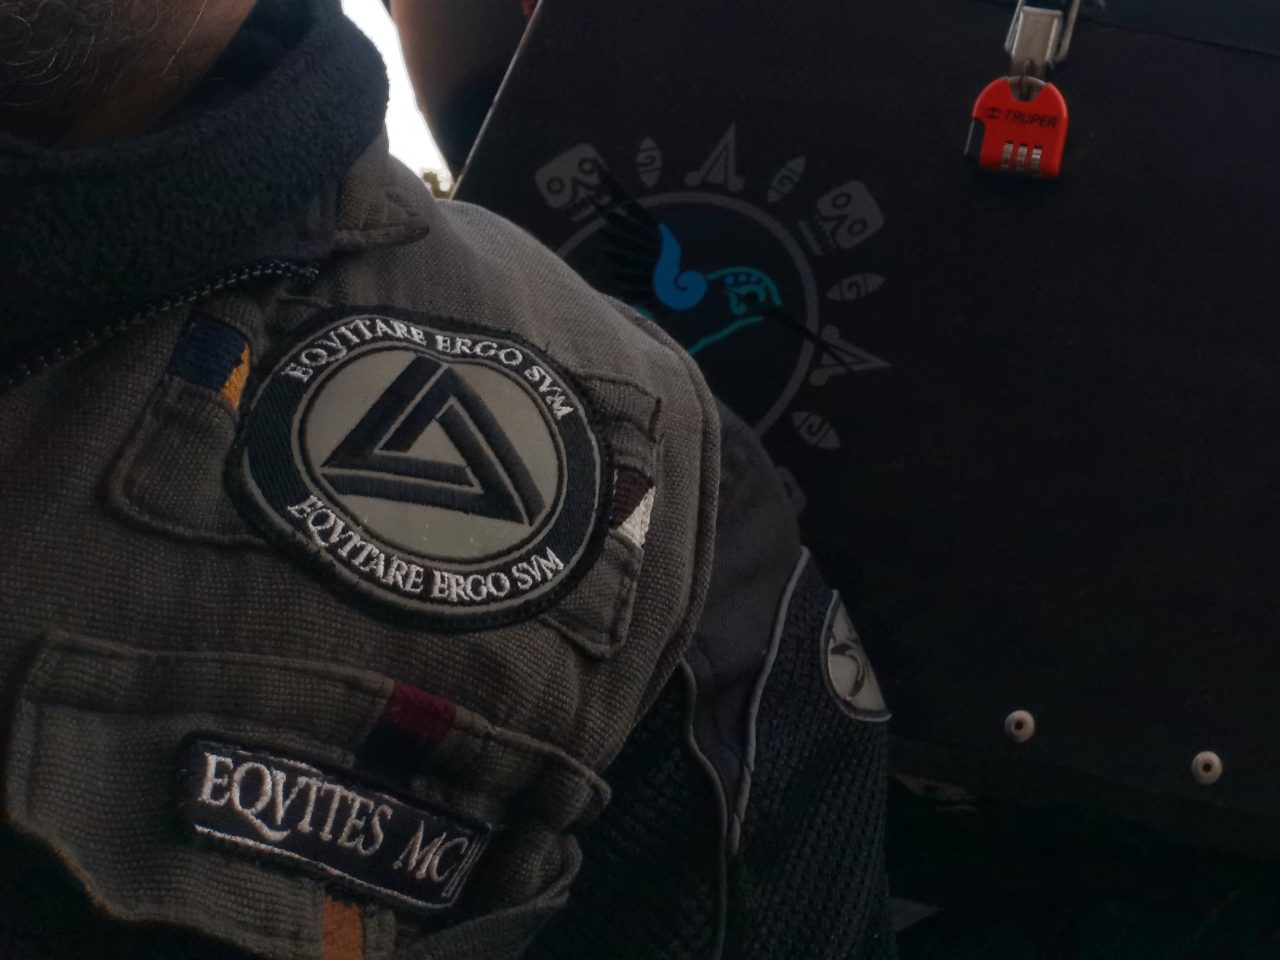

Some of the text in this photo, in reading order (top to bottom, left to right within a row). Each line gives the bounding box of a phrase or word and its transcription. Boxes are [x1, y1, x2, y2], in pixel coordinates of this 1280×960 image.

[1005, 109, 1057, 128] TRUPER
[435, 334, 523, 366] ERGO
[524, 365, 574, 419] SVM
[432, 569, 511, 602] ERGO
[511, 546, 565, 589] SVM
[198, 751, 468, 883] EQVITES MC
